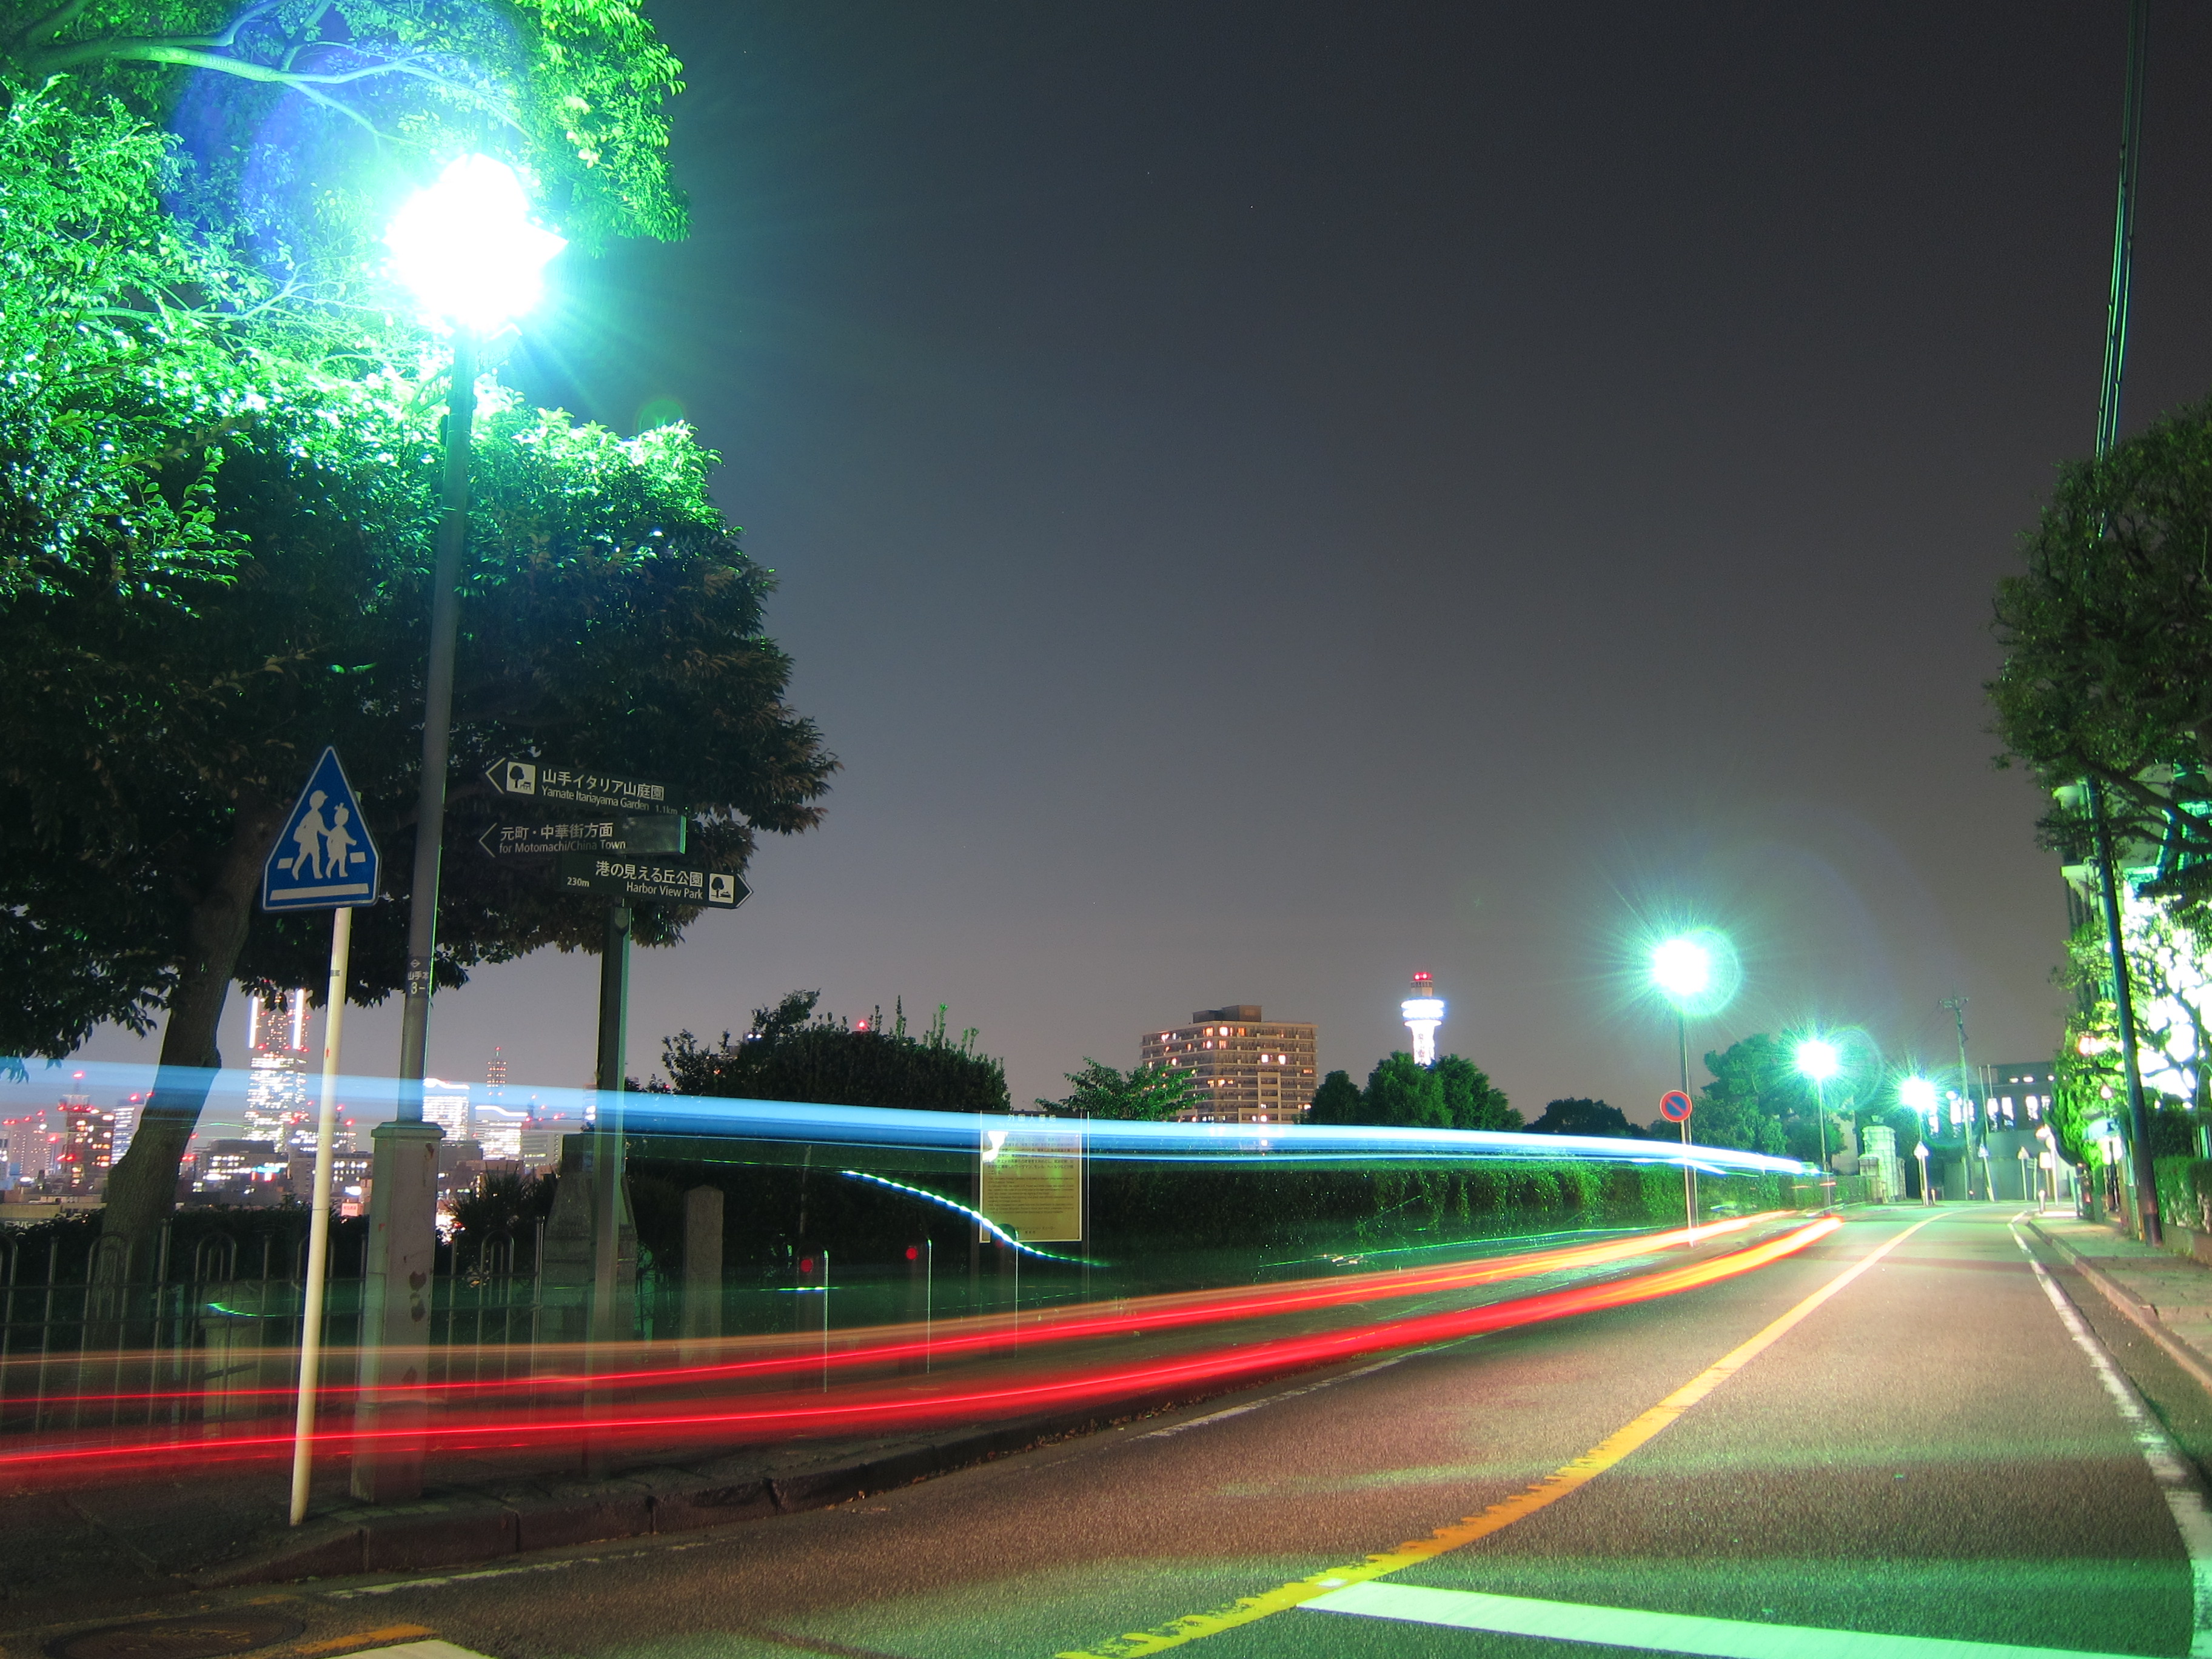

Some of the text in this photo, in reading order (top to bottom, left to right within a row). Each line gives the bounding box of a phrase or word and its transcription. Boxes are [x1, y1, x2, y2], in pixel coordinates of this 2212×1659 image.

[543, 768, 664, 801] 山手イタリア山庭園
[541, 785, 678, 815] Yamate Itariayama Garden 1.1km
[500, 822, 614, 842] 元町・中華街方面
[499, 839, 626, 854] for Motomachi/China Town
[567, 877, 590, 887] 230m
[595, 860, 703, 887] 港の見える丘公園
[626, 881, 703, 900] Harbor View Park
